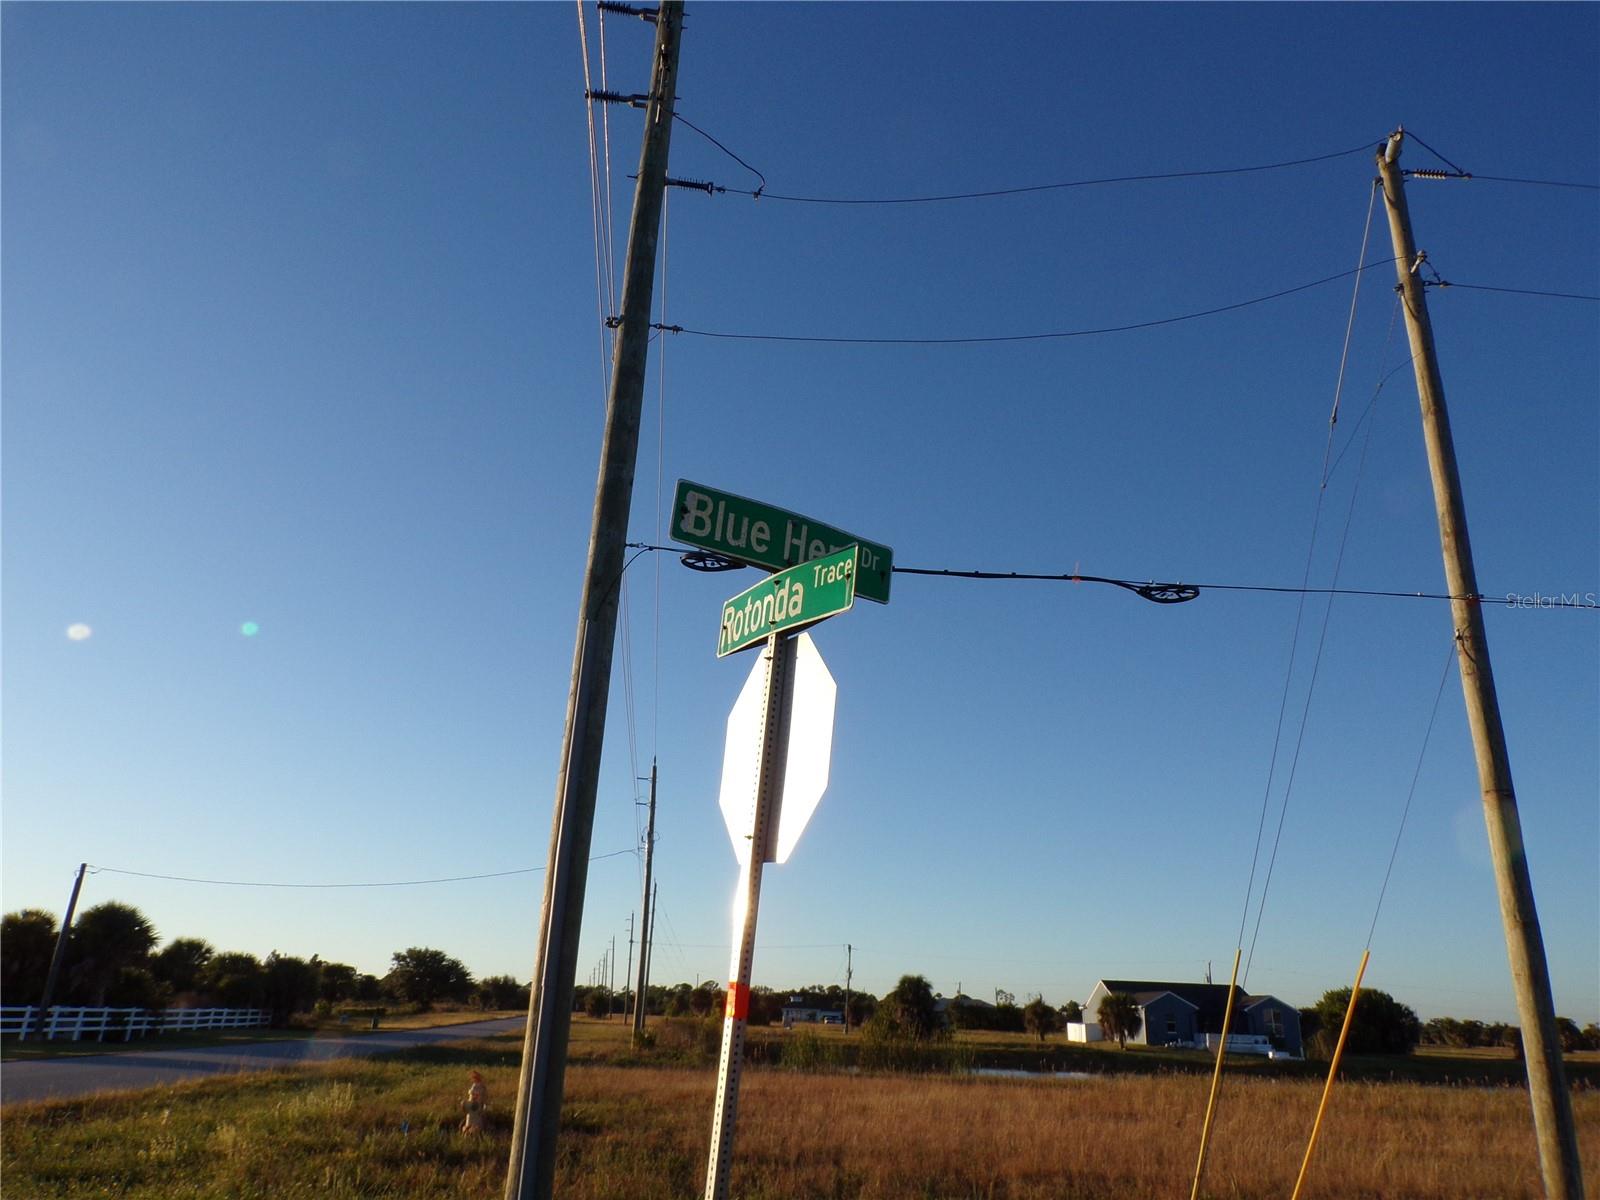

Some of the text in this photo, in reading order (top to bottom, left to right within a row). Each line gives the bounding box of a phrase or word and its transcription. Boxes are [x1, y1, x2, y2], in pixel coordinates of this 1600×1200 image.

[682, 490, 771, 553] Blue
[861, 547, 880, 571] Dr
[721, 558, 852, 646] Rotonda Trace
